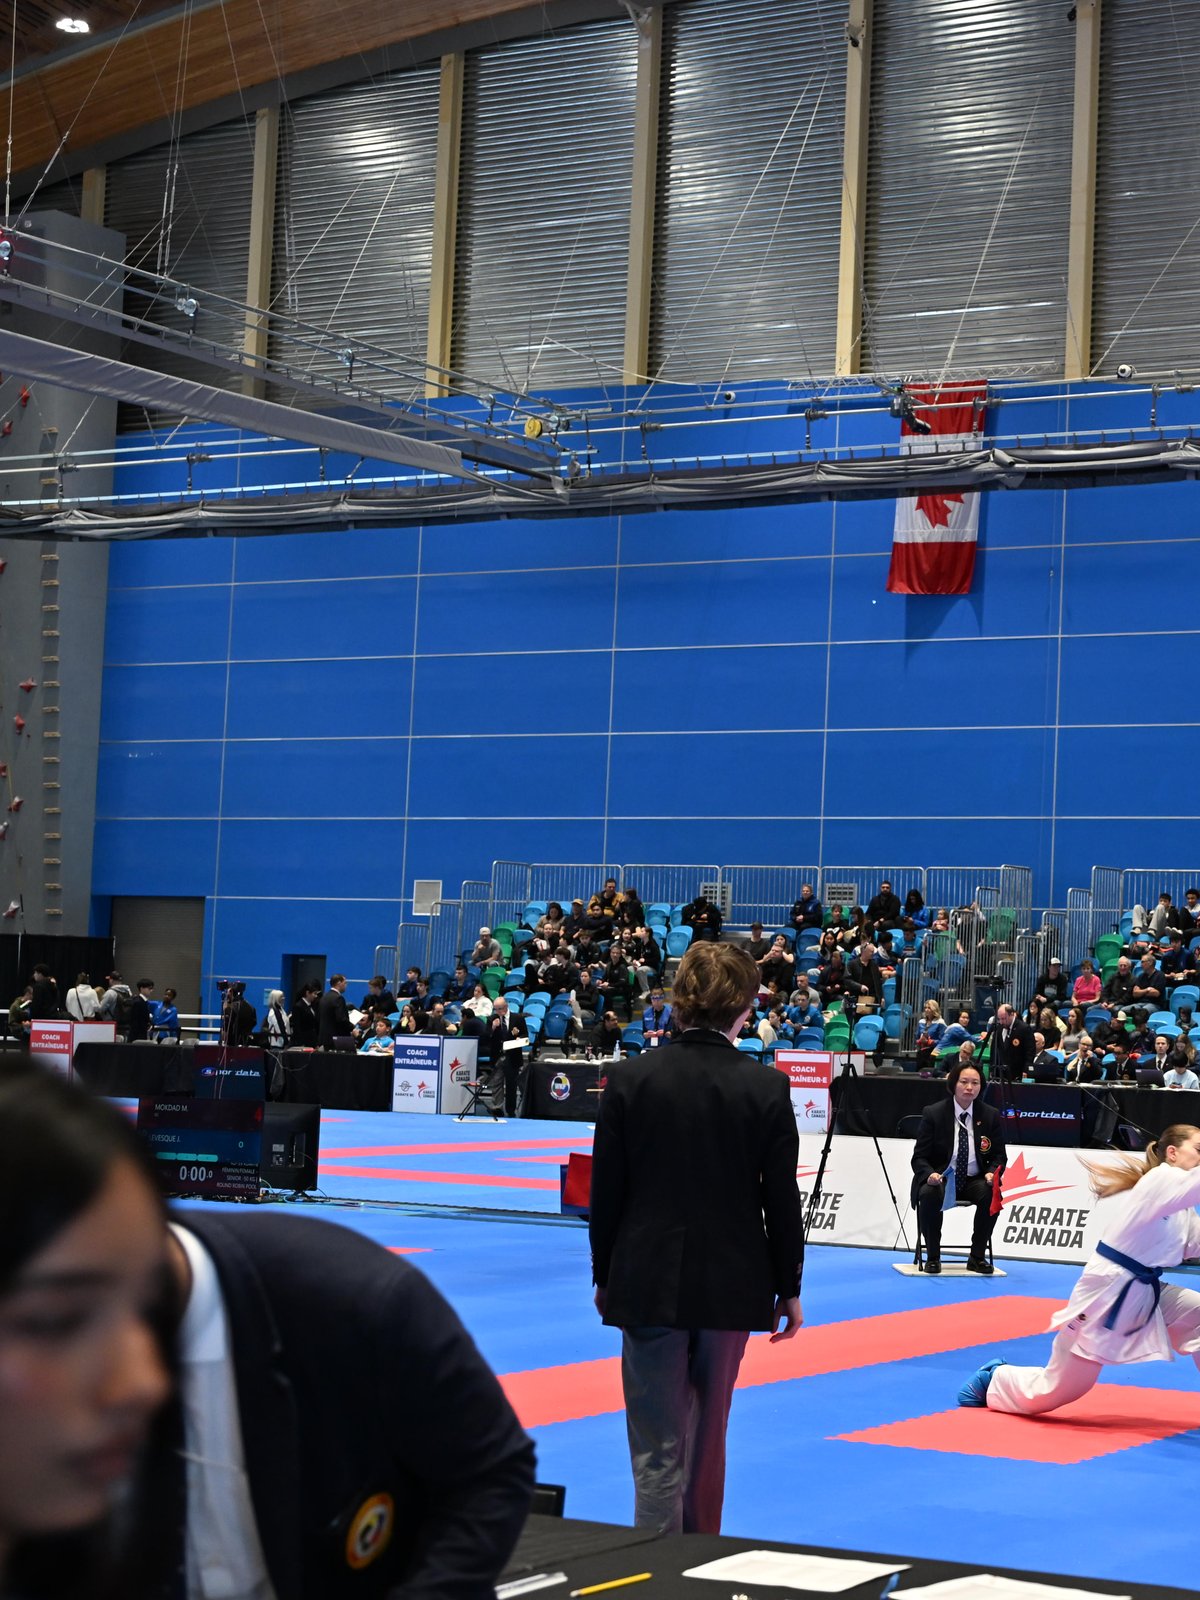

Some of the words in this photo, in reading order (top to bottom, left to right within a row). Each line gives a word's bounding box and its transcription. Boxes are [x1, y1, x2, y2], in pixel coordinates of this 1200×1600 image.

[790, 1065, 816, 1073] COACH
[150, 1134, 176, 1142] EVESQUE
[238, 1141, 244, 1149] 0
[1008, 1205, 1090, 1227] KARATE
[1003, 1226, 1083, 1249] CANADA
